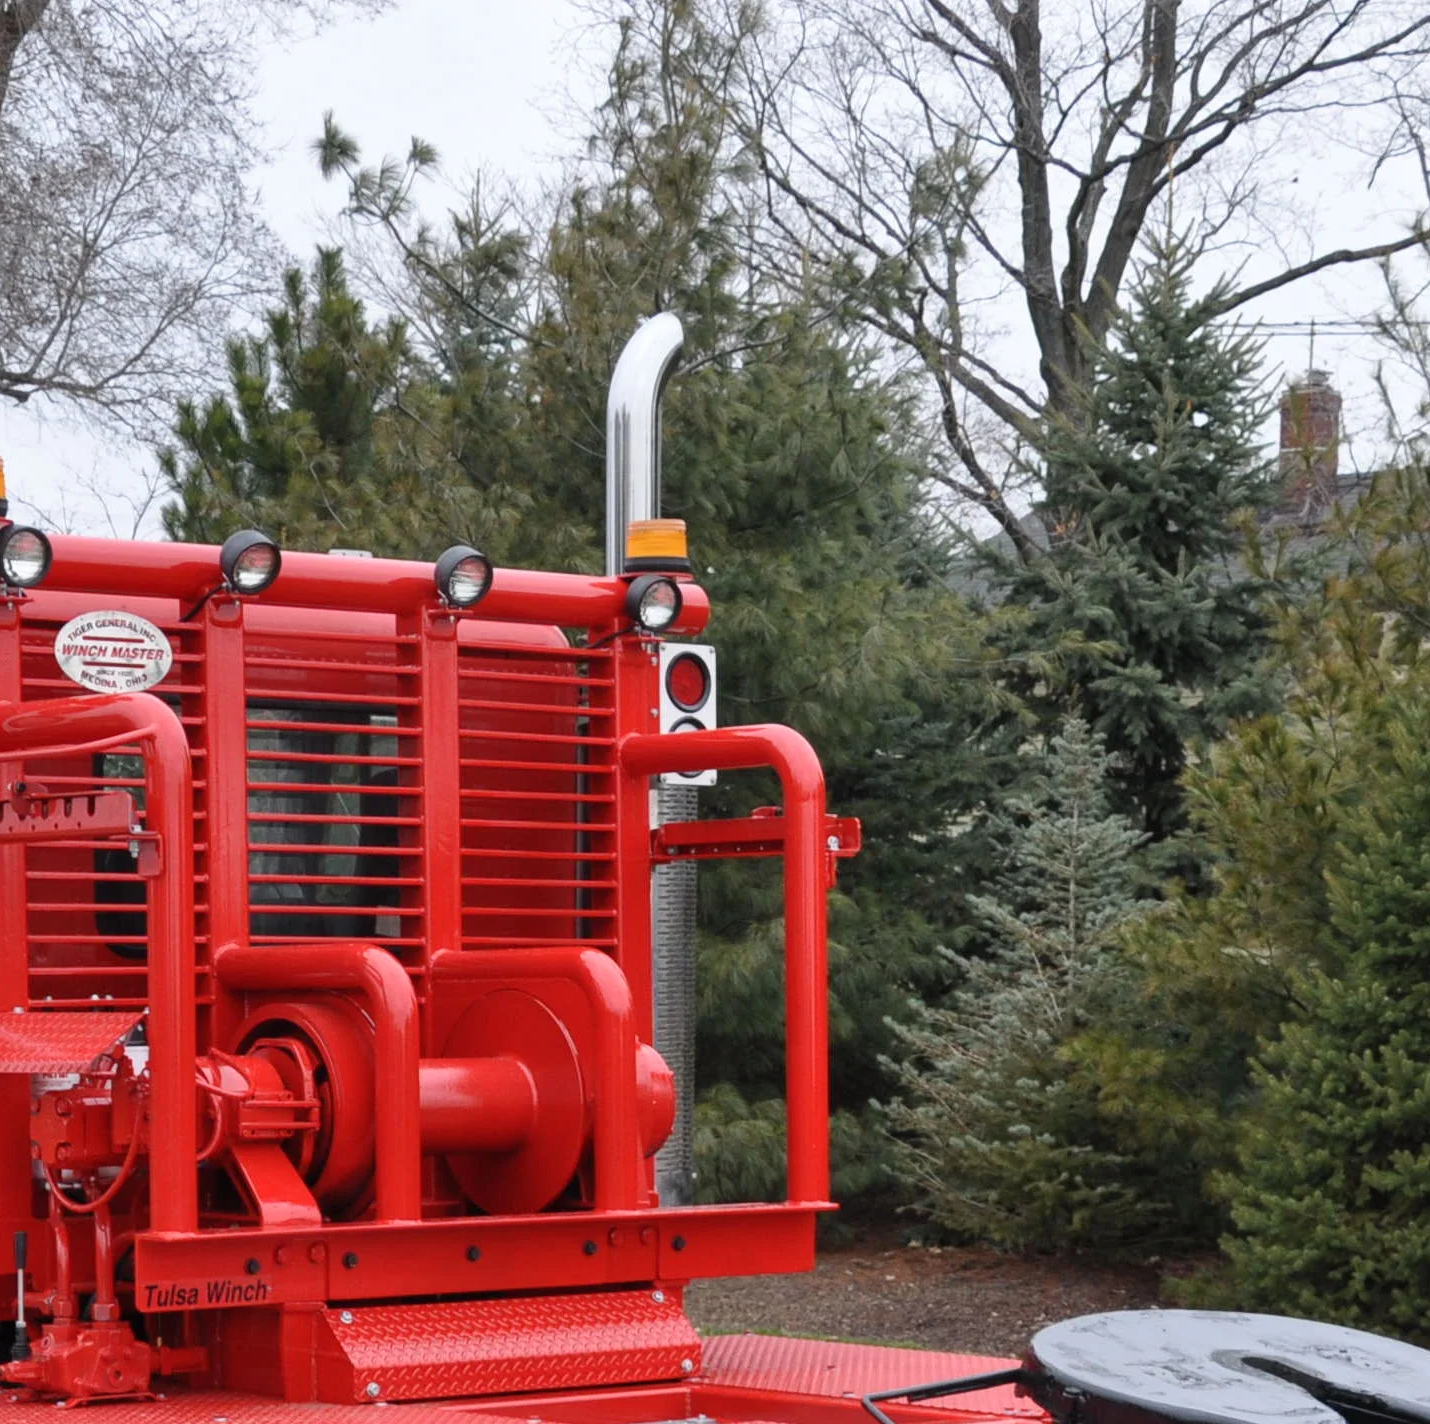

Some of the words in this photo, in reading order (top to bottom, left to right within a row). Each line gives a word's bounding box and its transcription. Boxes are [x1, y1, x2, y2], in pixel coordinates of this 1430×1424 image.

[68, 622, 94, 641] TIGER
[95, 619, 139, 633] GENERAL
[62, 643, 108, 657] WINCH
[110, 646, 165, 661] MASTER
[144, 1283, 200, 1308] Tulsa
[206, 1279, 268, 1304] Winch
